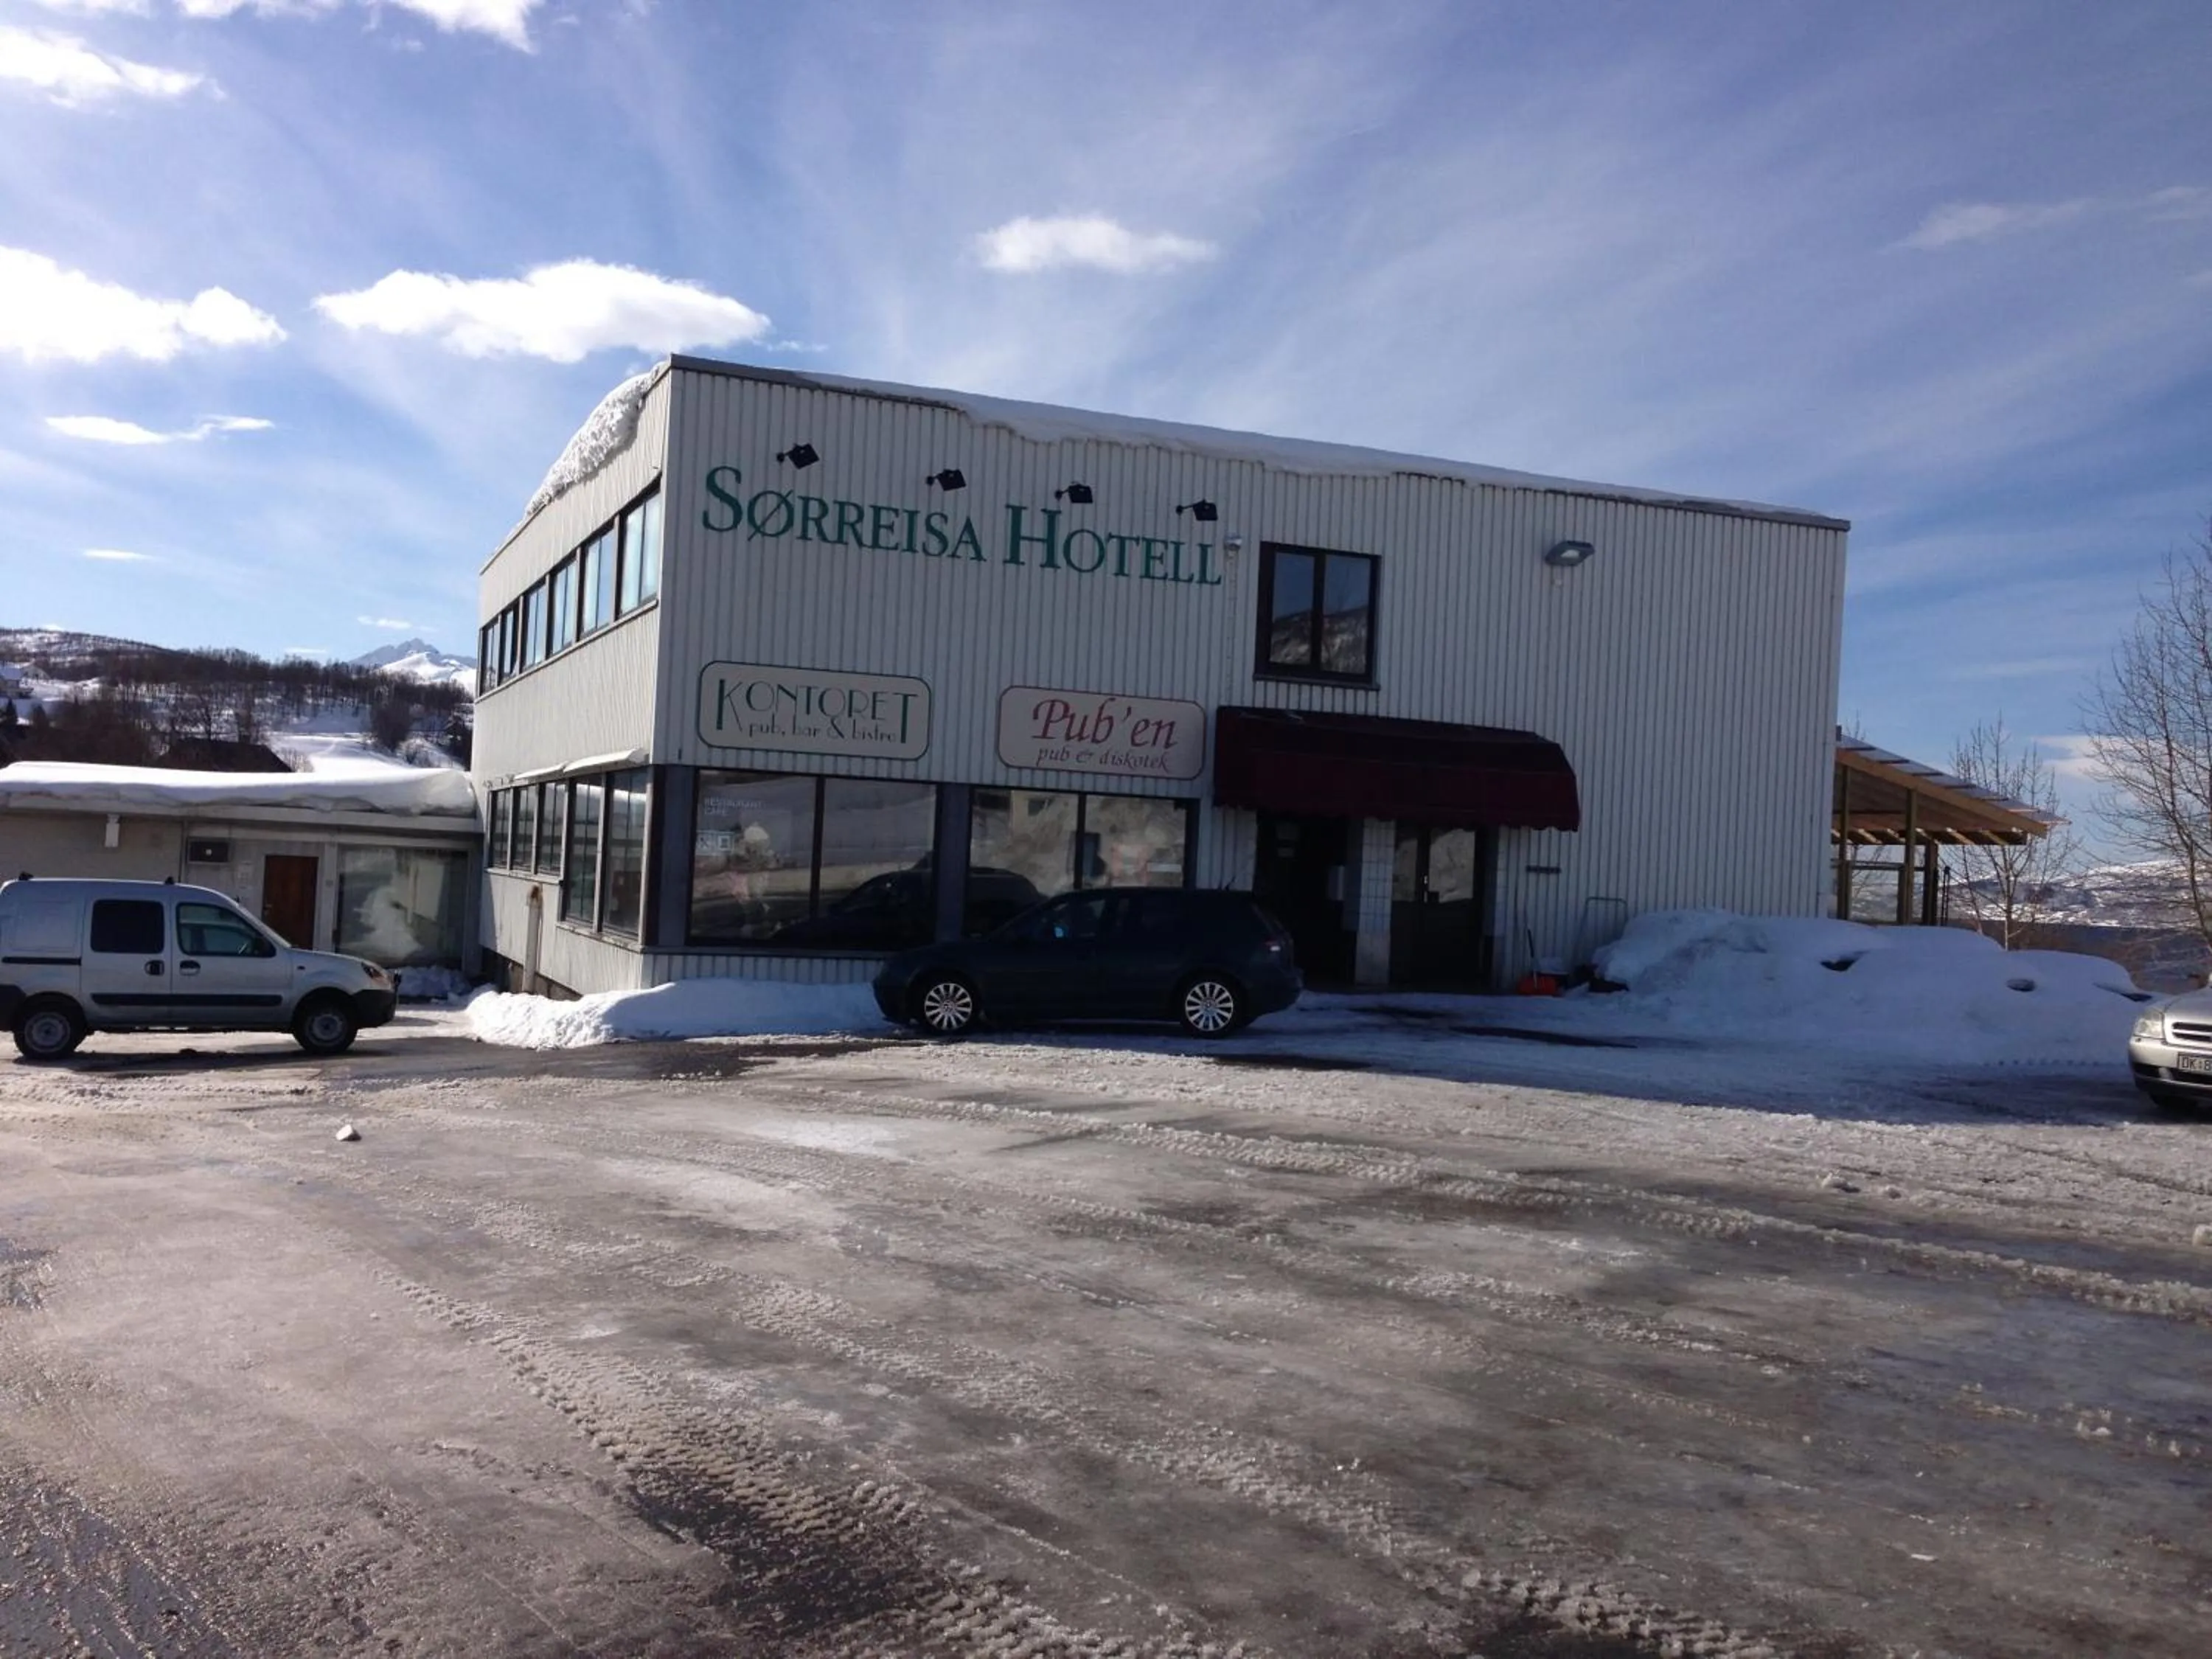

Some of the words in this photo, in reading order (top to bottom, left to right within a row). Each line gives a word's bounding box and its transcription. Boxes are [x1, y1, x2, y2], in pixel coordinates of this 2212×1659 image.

[701, 466, 986, 563] SØRREISA
[1003, 504, 1222, 586] HOTELL
[716, 678, 919, 744] KONTORET
[792, 714, 821, 737] bar
[852, 719, 897, 742] bistro
[1031, 698, 1178, 750] Pub'en
[1036, 746, 1071, 767] pub
[1076, 748, 1093, 764] &
[1099, 749, 1171, 773] diskotek
